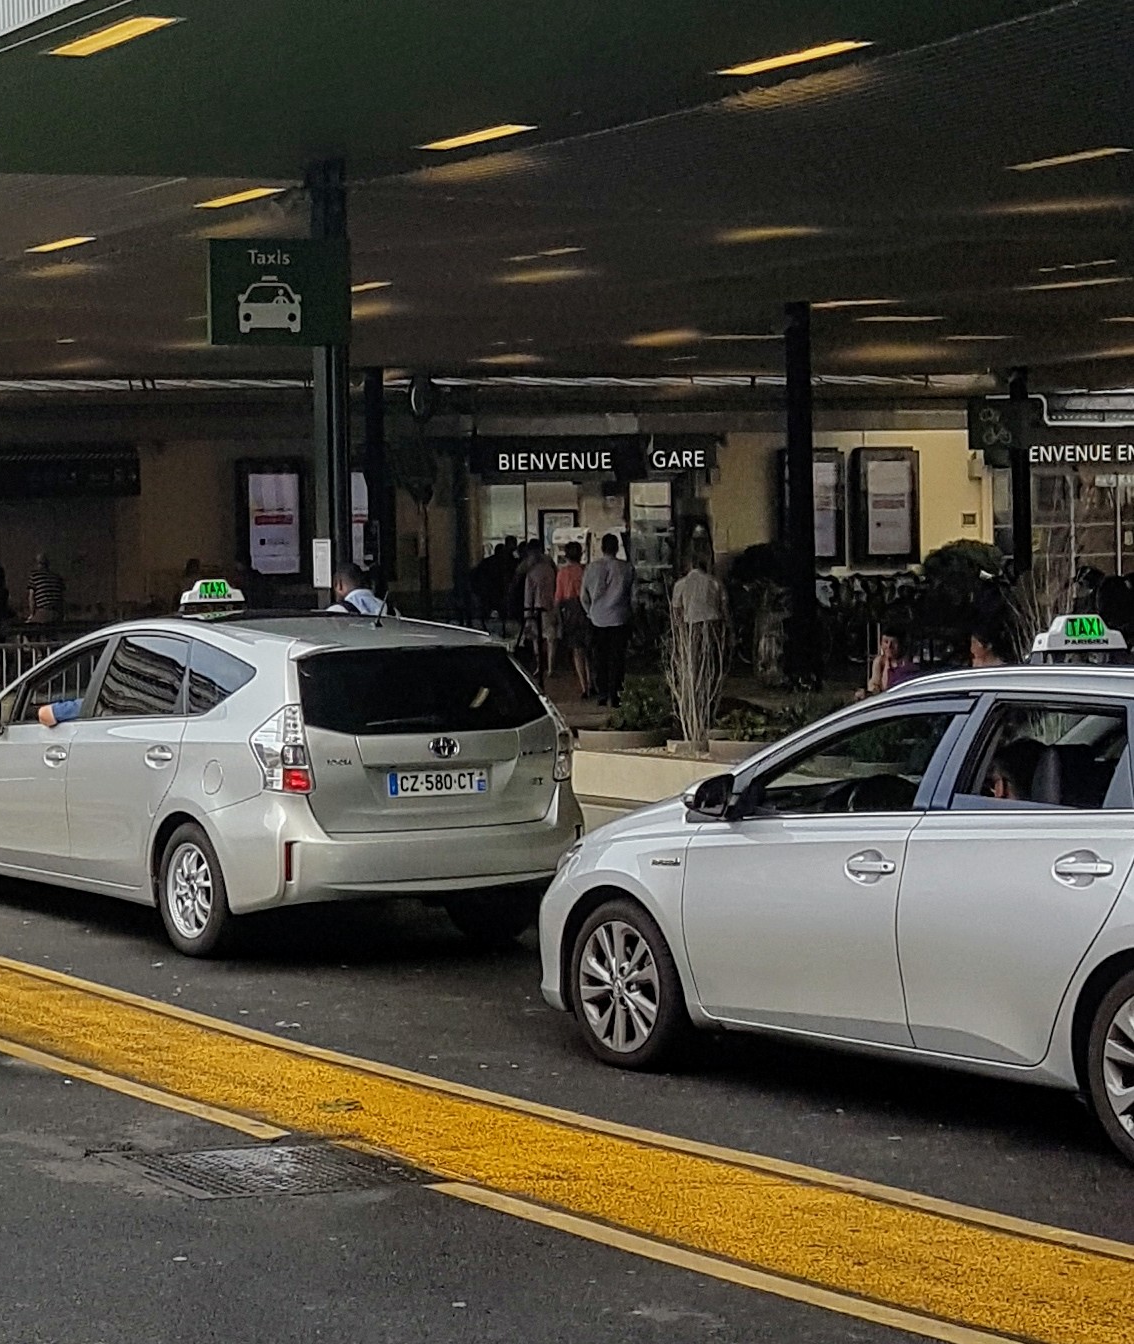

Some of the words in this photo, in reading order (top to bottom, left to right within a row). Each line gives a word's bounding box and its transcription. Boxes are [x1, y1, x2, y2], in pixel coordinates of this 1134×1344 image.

[247, 249, 290, 265] Taxis
[498, 452, 612, 471] BIENVENUE
[652, 450, 705, 468] GARE
[1029, 445, 1111, 462] ENVENUE
[202, 581, 228, 594] TAXI
[1068, 618, 1102, 636] TAXI
